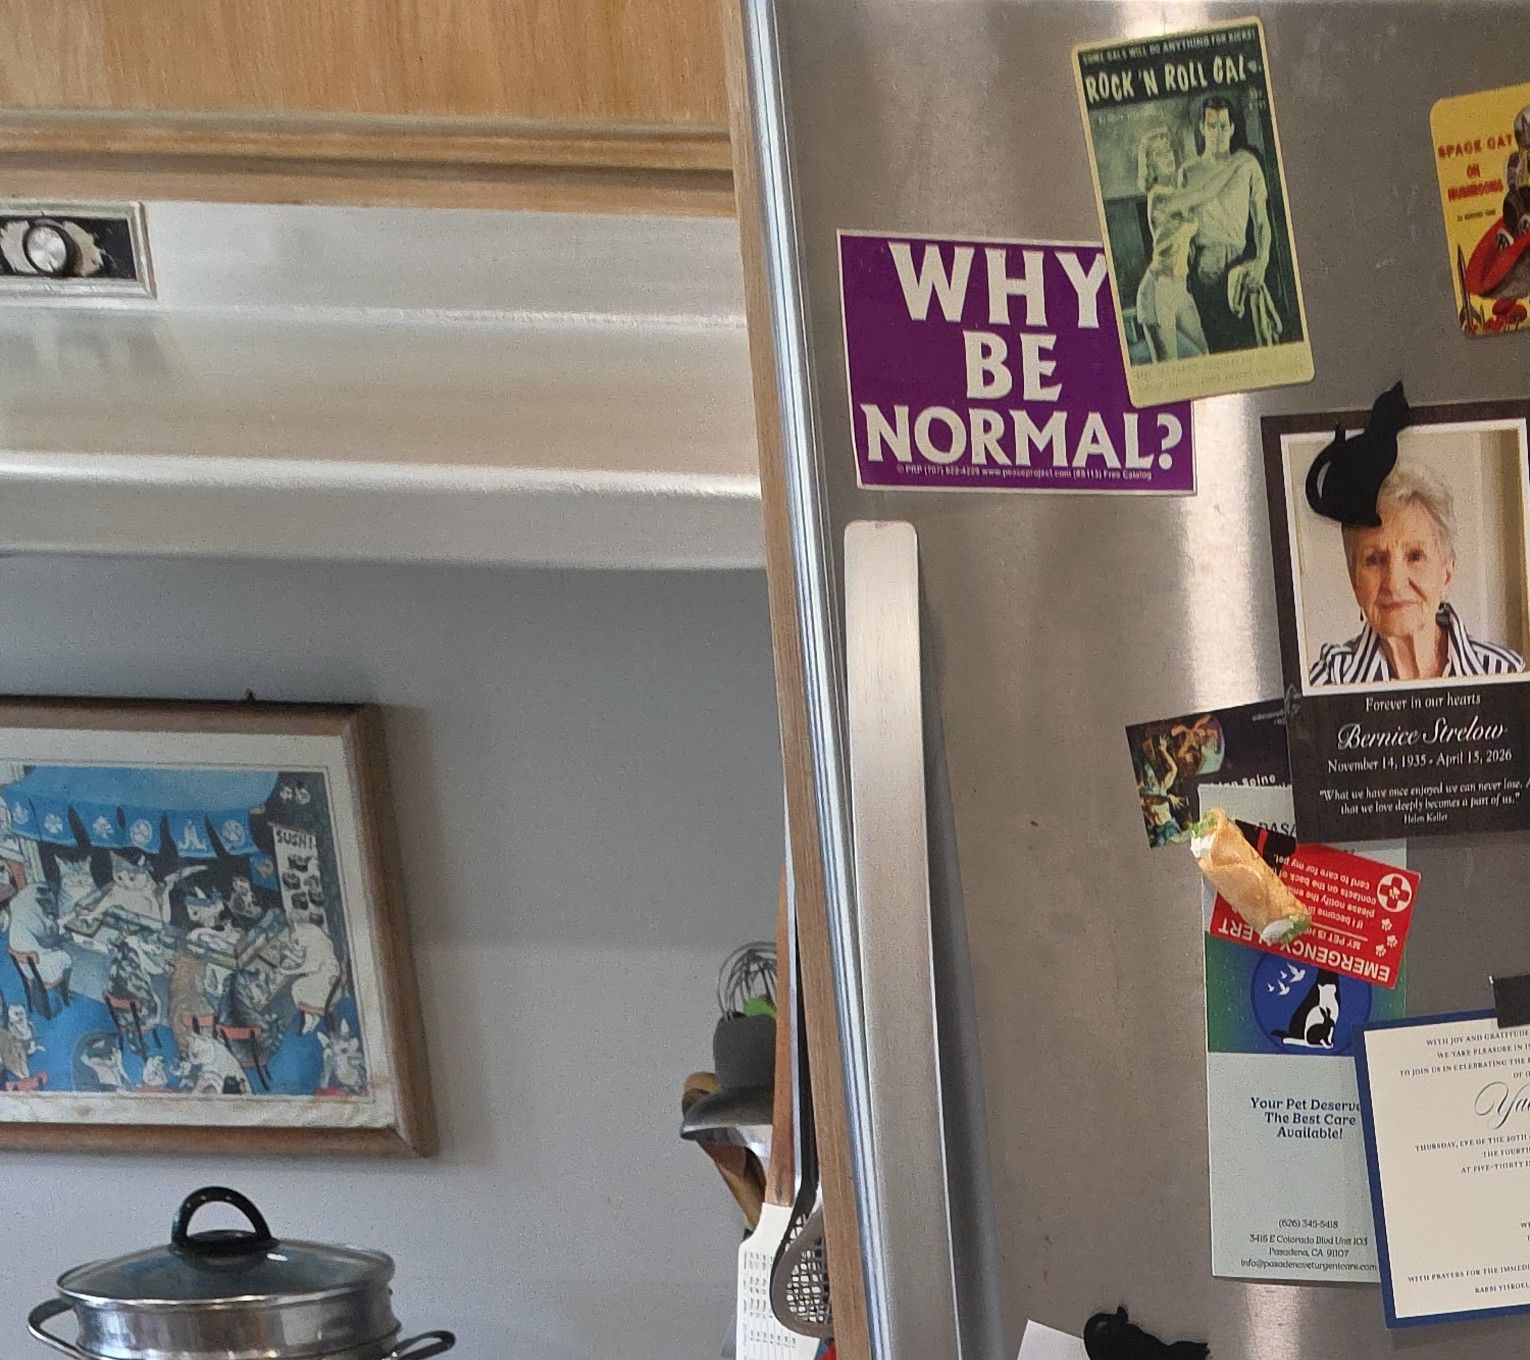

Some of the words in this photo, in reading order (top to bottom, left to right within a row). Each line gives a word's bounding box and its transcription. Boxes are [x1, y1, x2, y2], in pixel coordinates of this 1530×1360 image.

[1085, 70, 1134, 104] ROCK
[1164, 60, 1208, 92] ROLL
[1213, 53, 1246, 85] GAL
[1438, 140, 1483, 159] SPACE
[1487, 133, 1514, 149] CAT
[888, 241, 1107, 329] WHY
[962, 329, 1063, 402] BE
[860, 403, 1183, 470] NORMAL?
[1365, 697, 1408, 712] Forever
[1411, 695, 1422, 708] in
[1425, 696, 1444, 708] our
[1447, 692, 1481, 707] hearts
[1337, 723, 1420, 750] Bernice
[1422, 715, 1505, 744] Strelow
[1328, 757, 1379, 774] November
[1381, 755, 1398, 771] 14,
[1401, 753, 1427, 768] 1935
[1436, 751, 1464, 768] April
[1467, 750, 1483, 765] 15,
[1486, 748, 1512, 762] 2026
[275, 828, 316, 851] SUSHI
[1280, 939, 1390, 983] EMERGENCY
[1251, 1097, 1283, 1111] Your
[1287, 1098, 1306, 1111] Pet
[1265, 1113, 1289, 1124] The
[1292, 1113, 1320, 1125] Best
[1324, 1114, 1356, 1126] Care
[1277, 1126, 1343, 1140] Available!
[1311, 1248, 1324, 1257] CA
